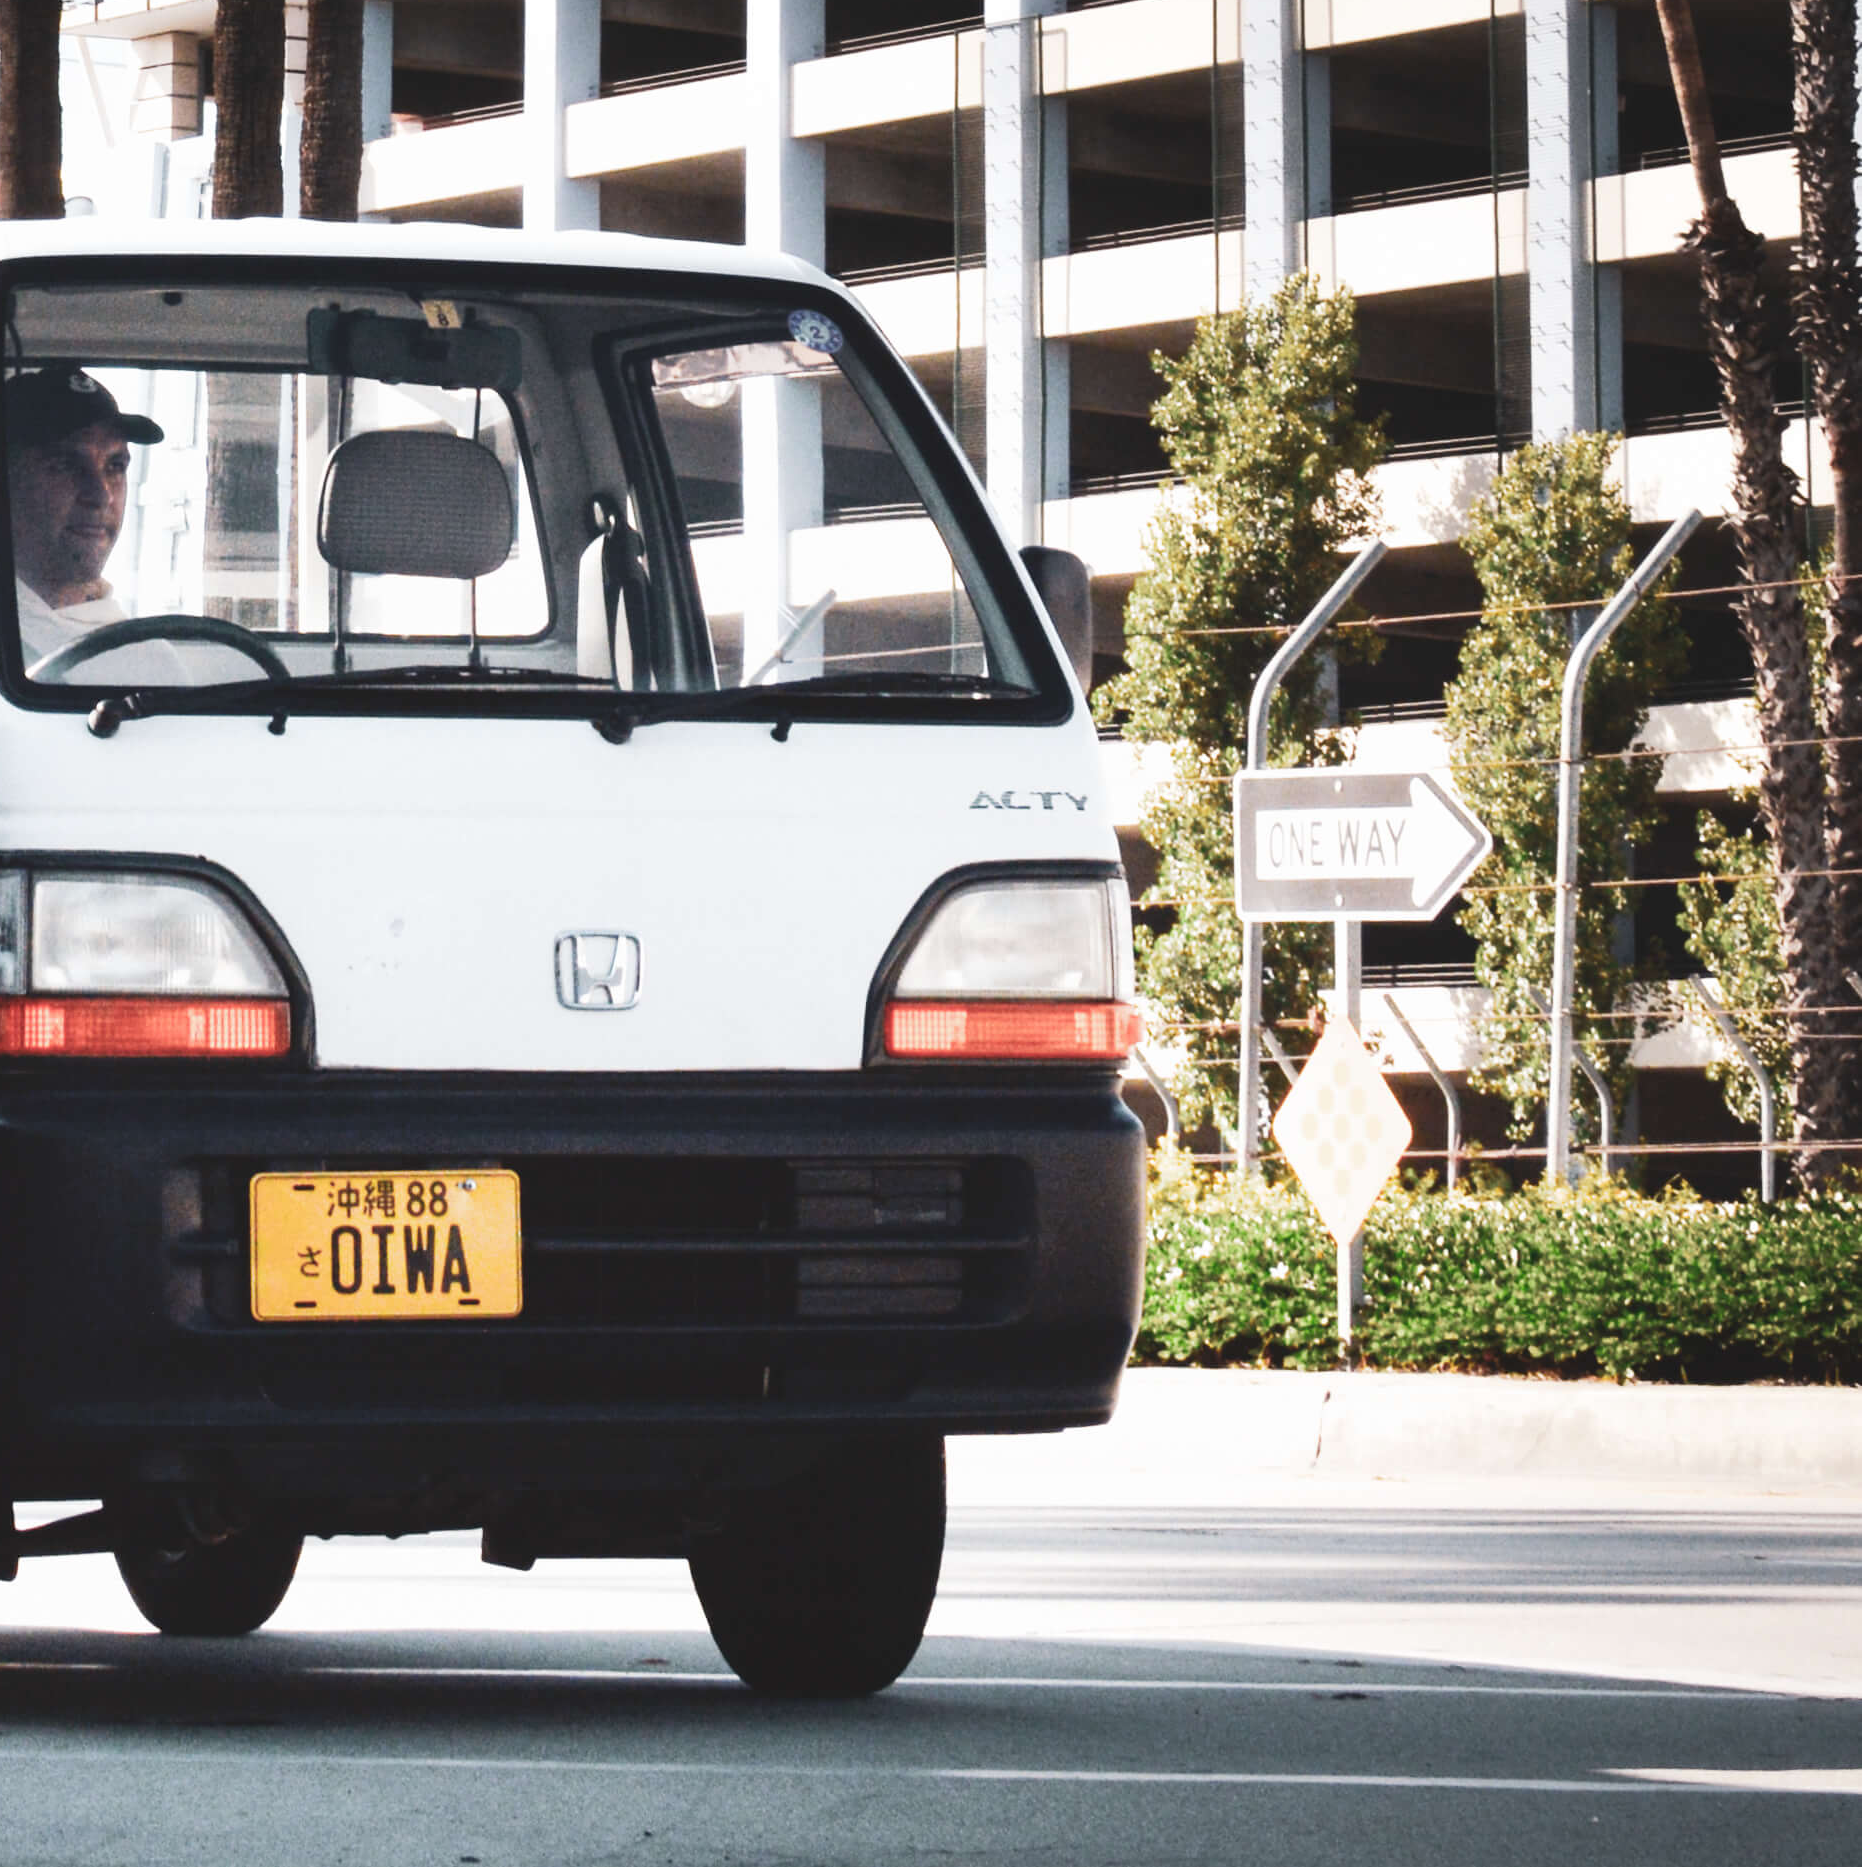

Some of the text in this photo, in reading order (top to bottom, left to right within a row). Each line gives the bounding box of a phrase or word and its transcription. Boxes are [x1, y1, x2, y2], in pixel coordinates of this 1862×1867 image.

[969, 790, 1088, 812] ACTY
[1269, 819, 1406, 869] ONE WAY
[327, 1180, 448, 1218] 沖縄 88
[297, 1224, 471, 1295] さ OIWA
